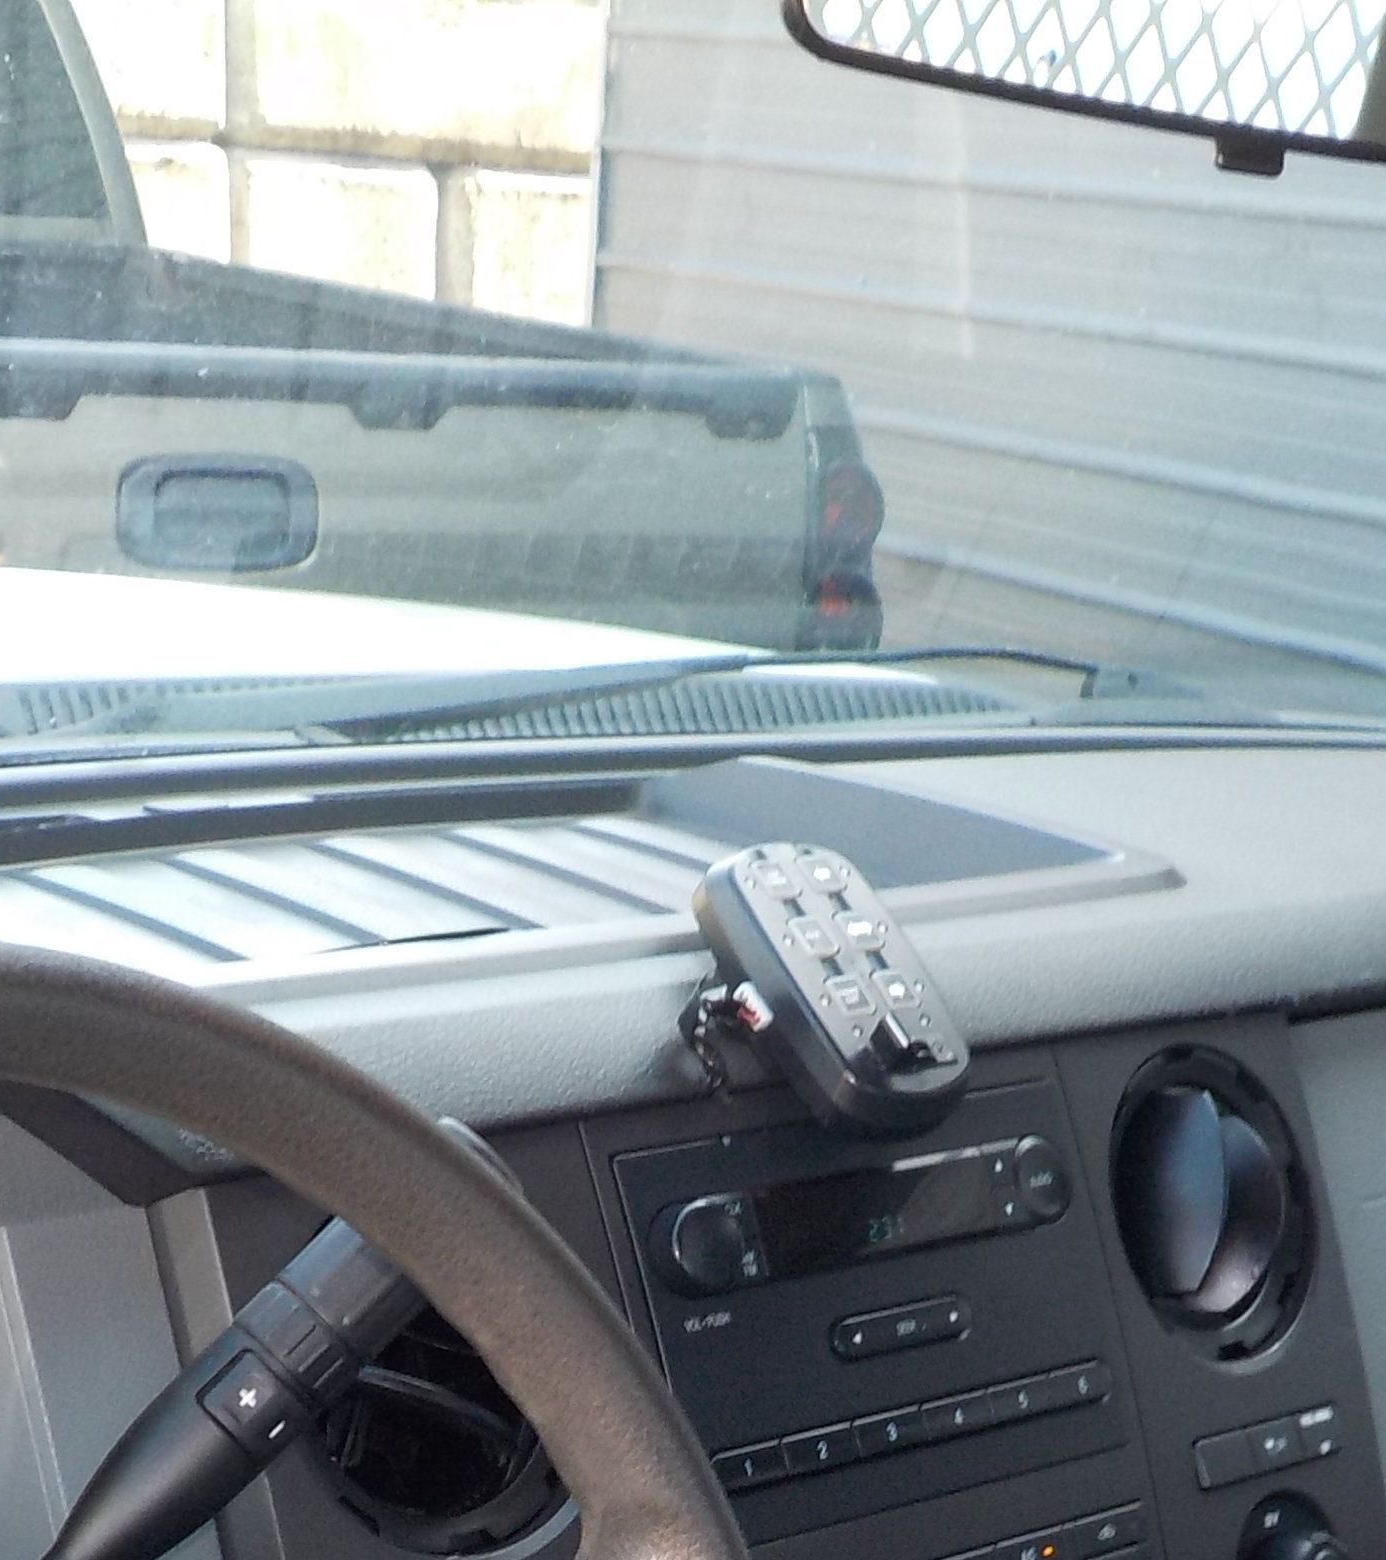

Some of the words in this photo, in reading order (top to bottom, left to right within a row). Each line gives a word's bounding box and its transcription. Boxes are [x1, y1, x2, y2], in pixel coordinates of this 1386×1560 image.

[744, 1457, 754, 1478] 1
[816, 1440, 830, 1460] 2
[887, 1421, 900, 1442] 3
[953, 1407, 965, 1426] 4
[1018, 1390, 1029, 1409] 5
